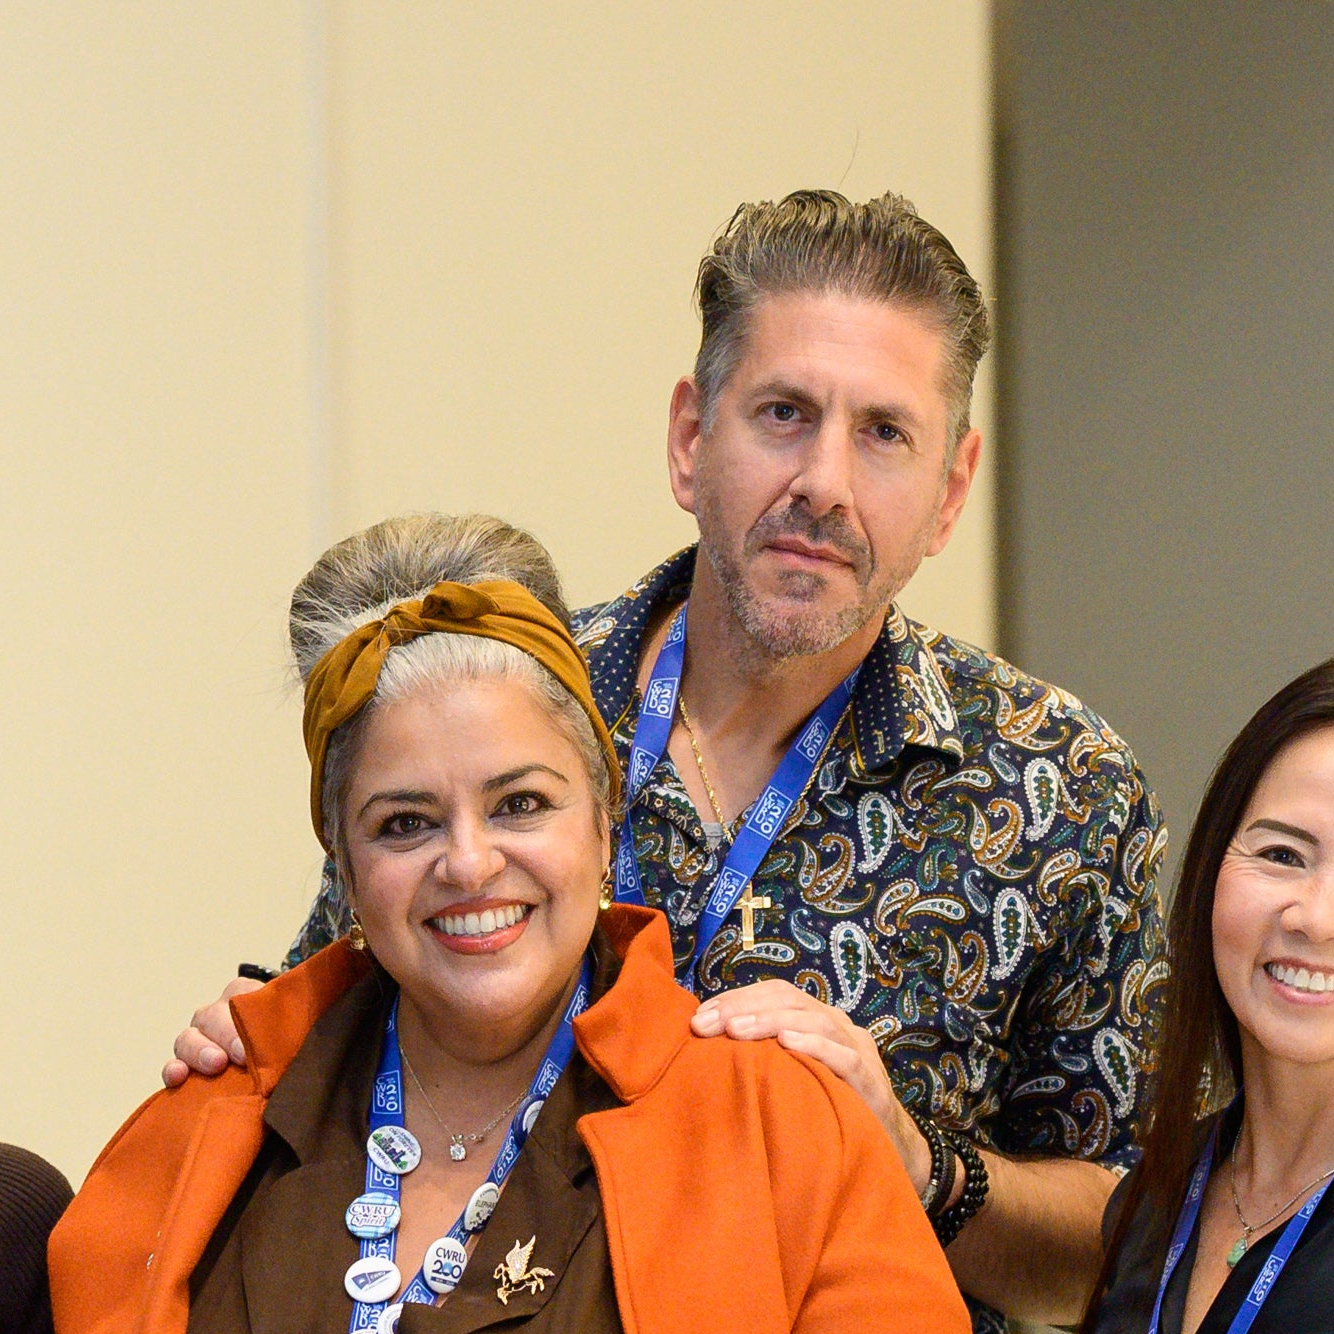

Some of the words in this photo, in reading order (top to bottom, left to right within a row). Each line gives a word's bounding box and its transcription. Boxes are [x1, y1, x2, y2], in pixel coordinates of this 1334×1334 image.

[649, 680, 662, 708] CWRU
[755, 792, 777, 824] CWRU
[712, 872, 733, 905] CWRU
[376, 1076, 387, 1107] CWRU
[351, 1205, 395, 1216] CWRU
[354, 1216, 384, 1226] Spirit
[435, 1246, 465, 1264] CWRU
